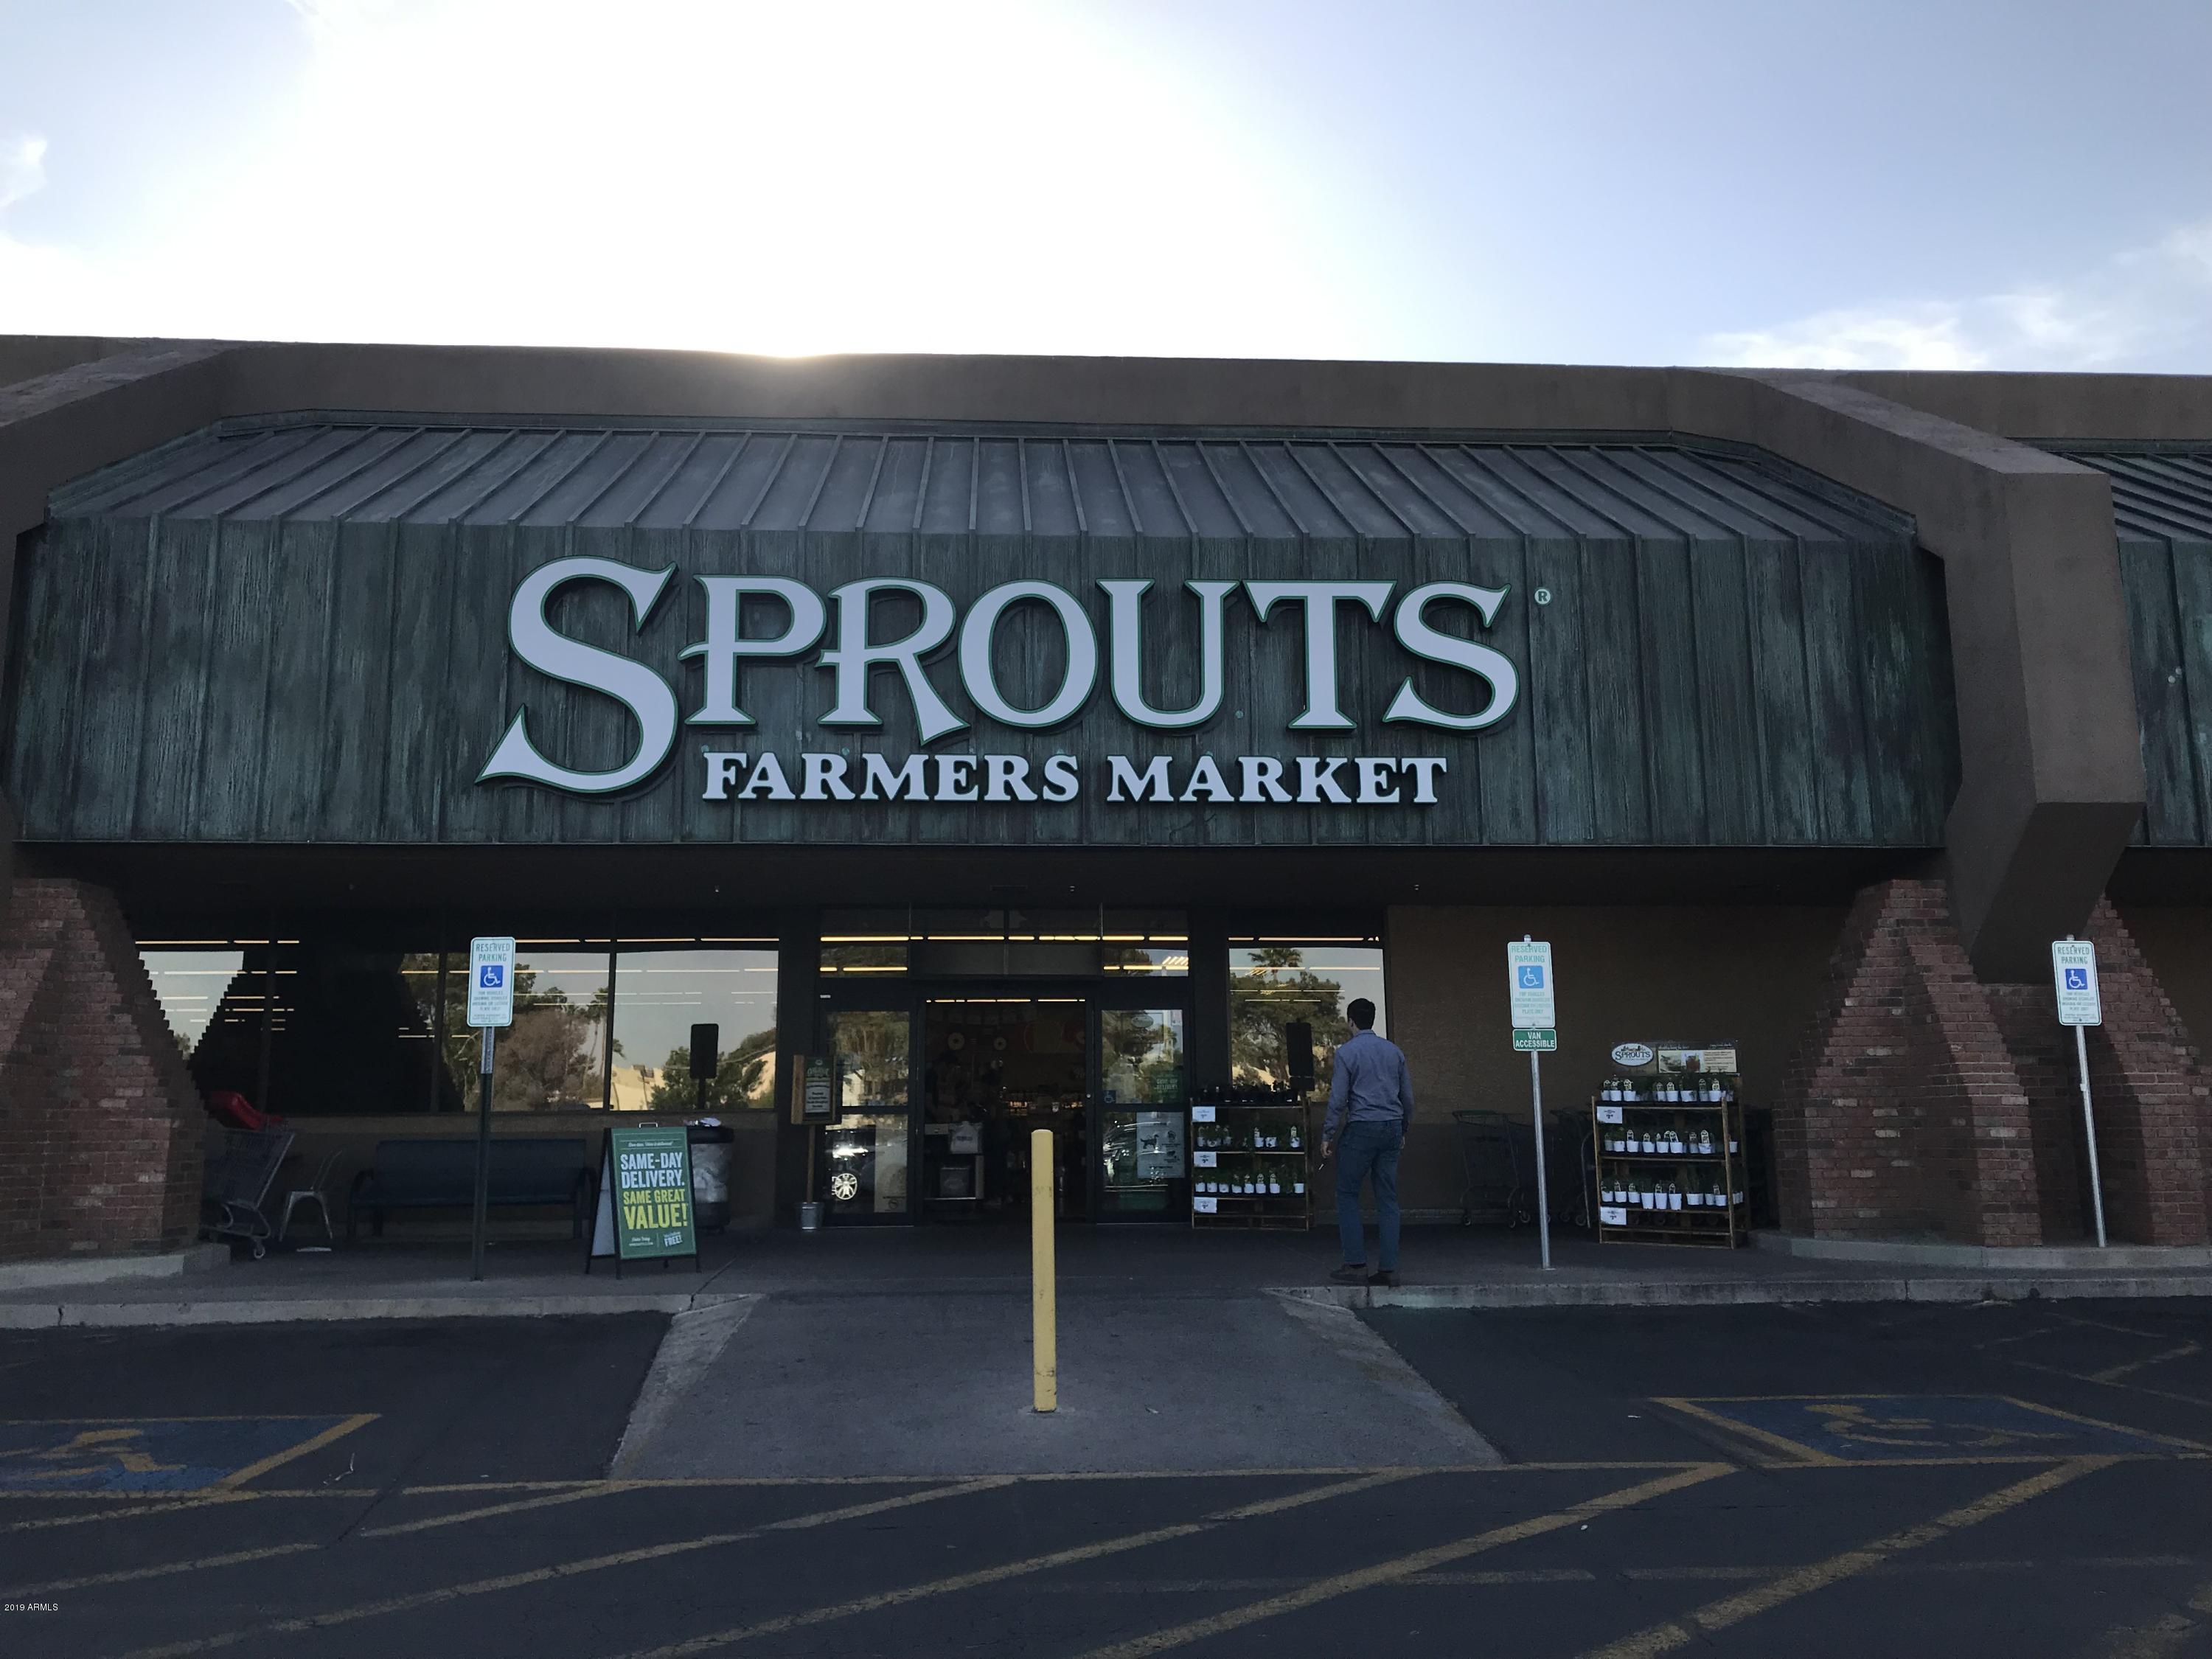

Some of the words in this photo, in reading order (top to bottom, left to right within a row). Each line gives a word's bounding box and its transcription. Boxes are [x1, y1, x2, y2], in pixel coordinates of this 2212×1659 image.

[475, 555, 1520, 793] SPROUTS
[703, 752, 1079, 803] FARMERS
[1107, 755, 1447, 804] MARKET
[476, 943, 510, 952] RESERVED
[1512, 945, 1547, 953] RESERVED
[2057, 947, 2090, 955] RESERVED
[479, 953, 507, 962] PARKING
[1514, 955, 1545, 963] PARKING
[2062, 956, 2088, 964] PARKING
[1527, 1032, 1541, 1040] VAN
[1514, 1040, 1555, 1048] ACCESSIBLE
[1615, 1051, 1651, 1060] SPROUTS
[620, 1152, 683, 1170] SAME-DAY
[621, 1169, 685, 1189] DELIVERY.
[623, 1190, 652, 1205] SAME
[654, 1189, 685, 1203] GREAT
